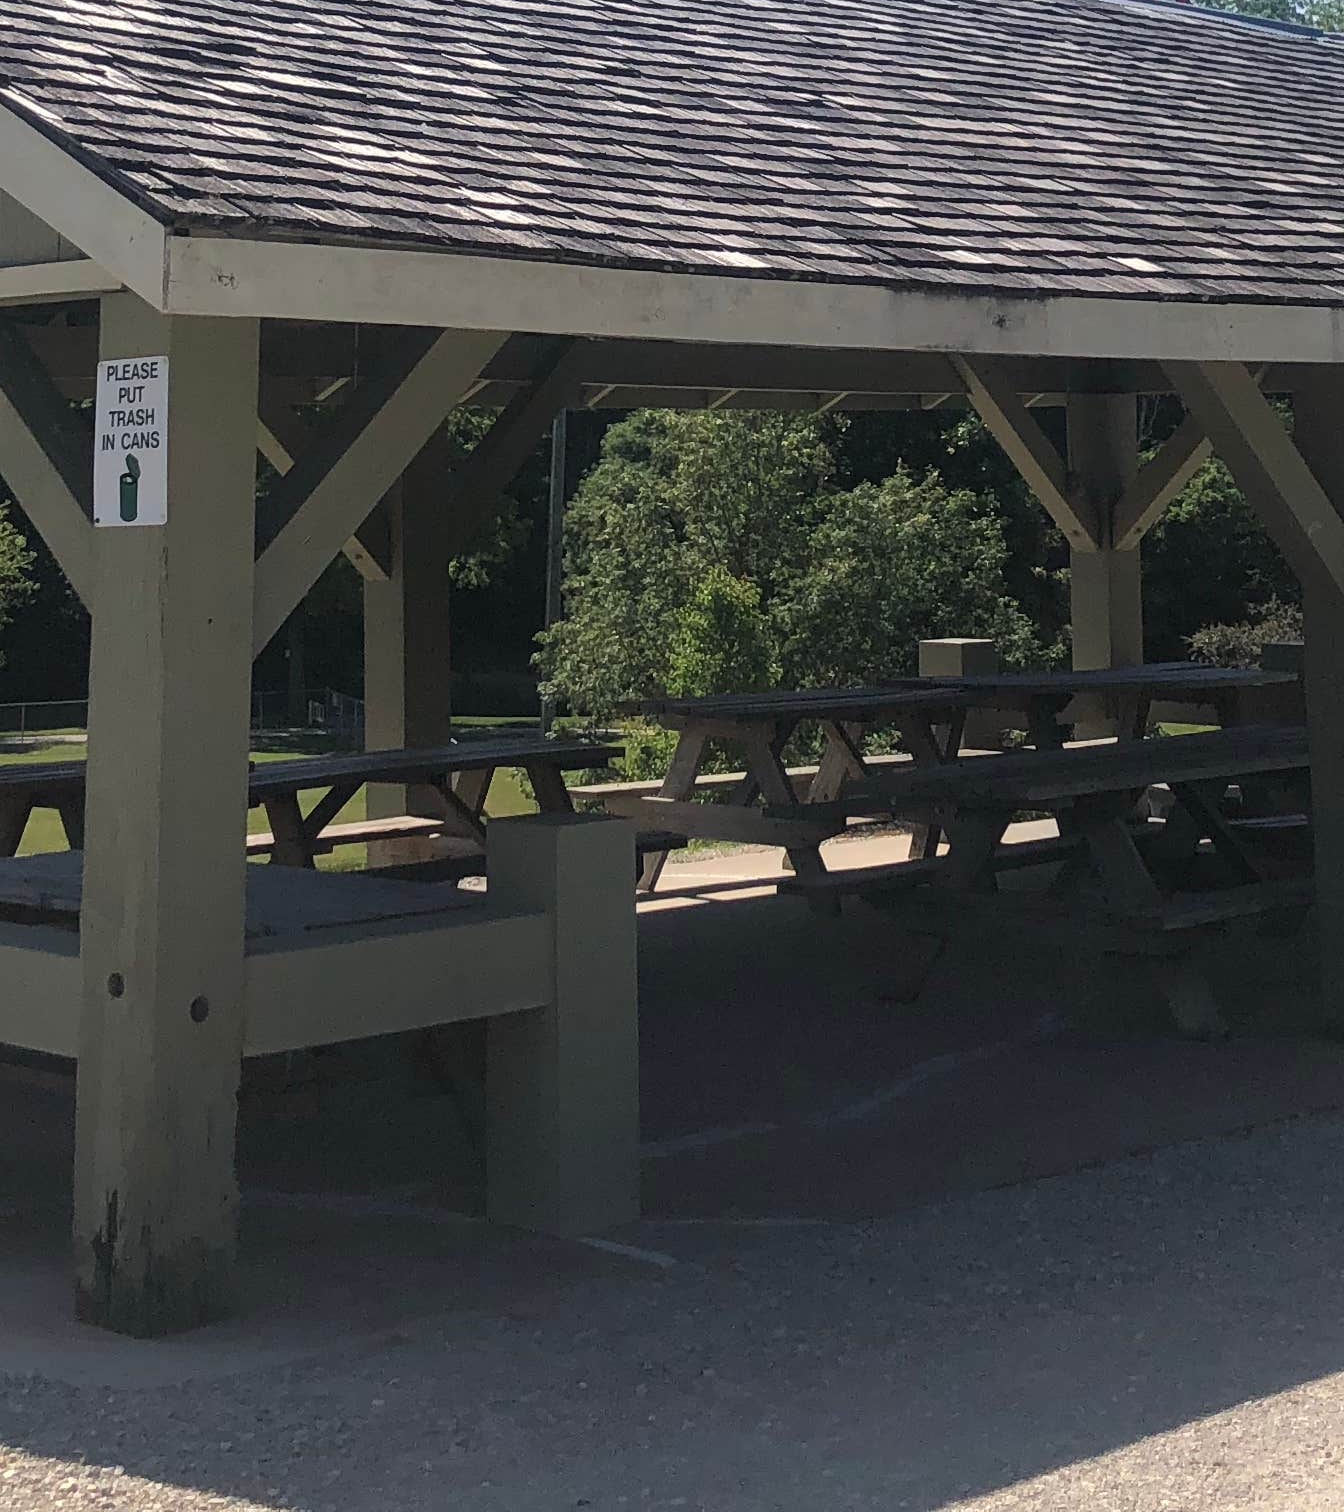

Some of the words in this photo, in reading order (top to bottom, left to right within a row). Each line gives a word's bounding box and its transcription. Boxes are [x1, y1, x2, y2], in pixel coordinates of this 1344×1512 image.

[106, 361, 159, 382] PLEASE
[118, 386, 145, 404] PUT
[109, 408, 155, 427] TRASH
[102, 433, 116, 450] IN
[120, 430, 160, 450] CANS
